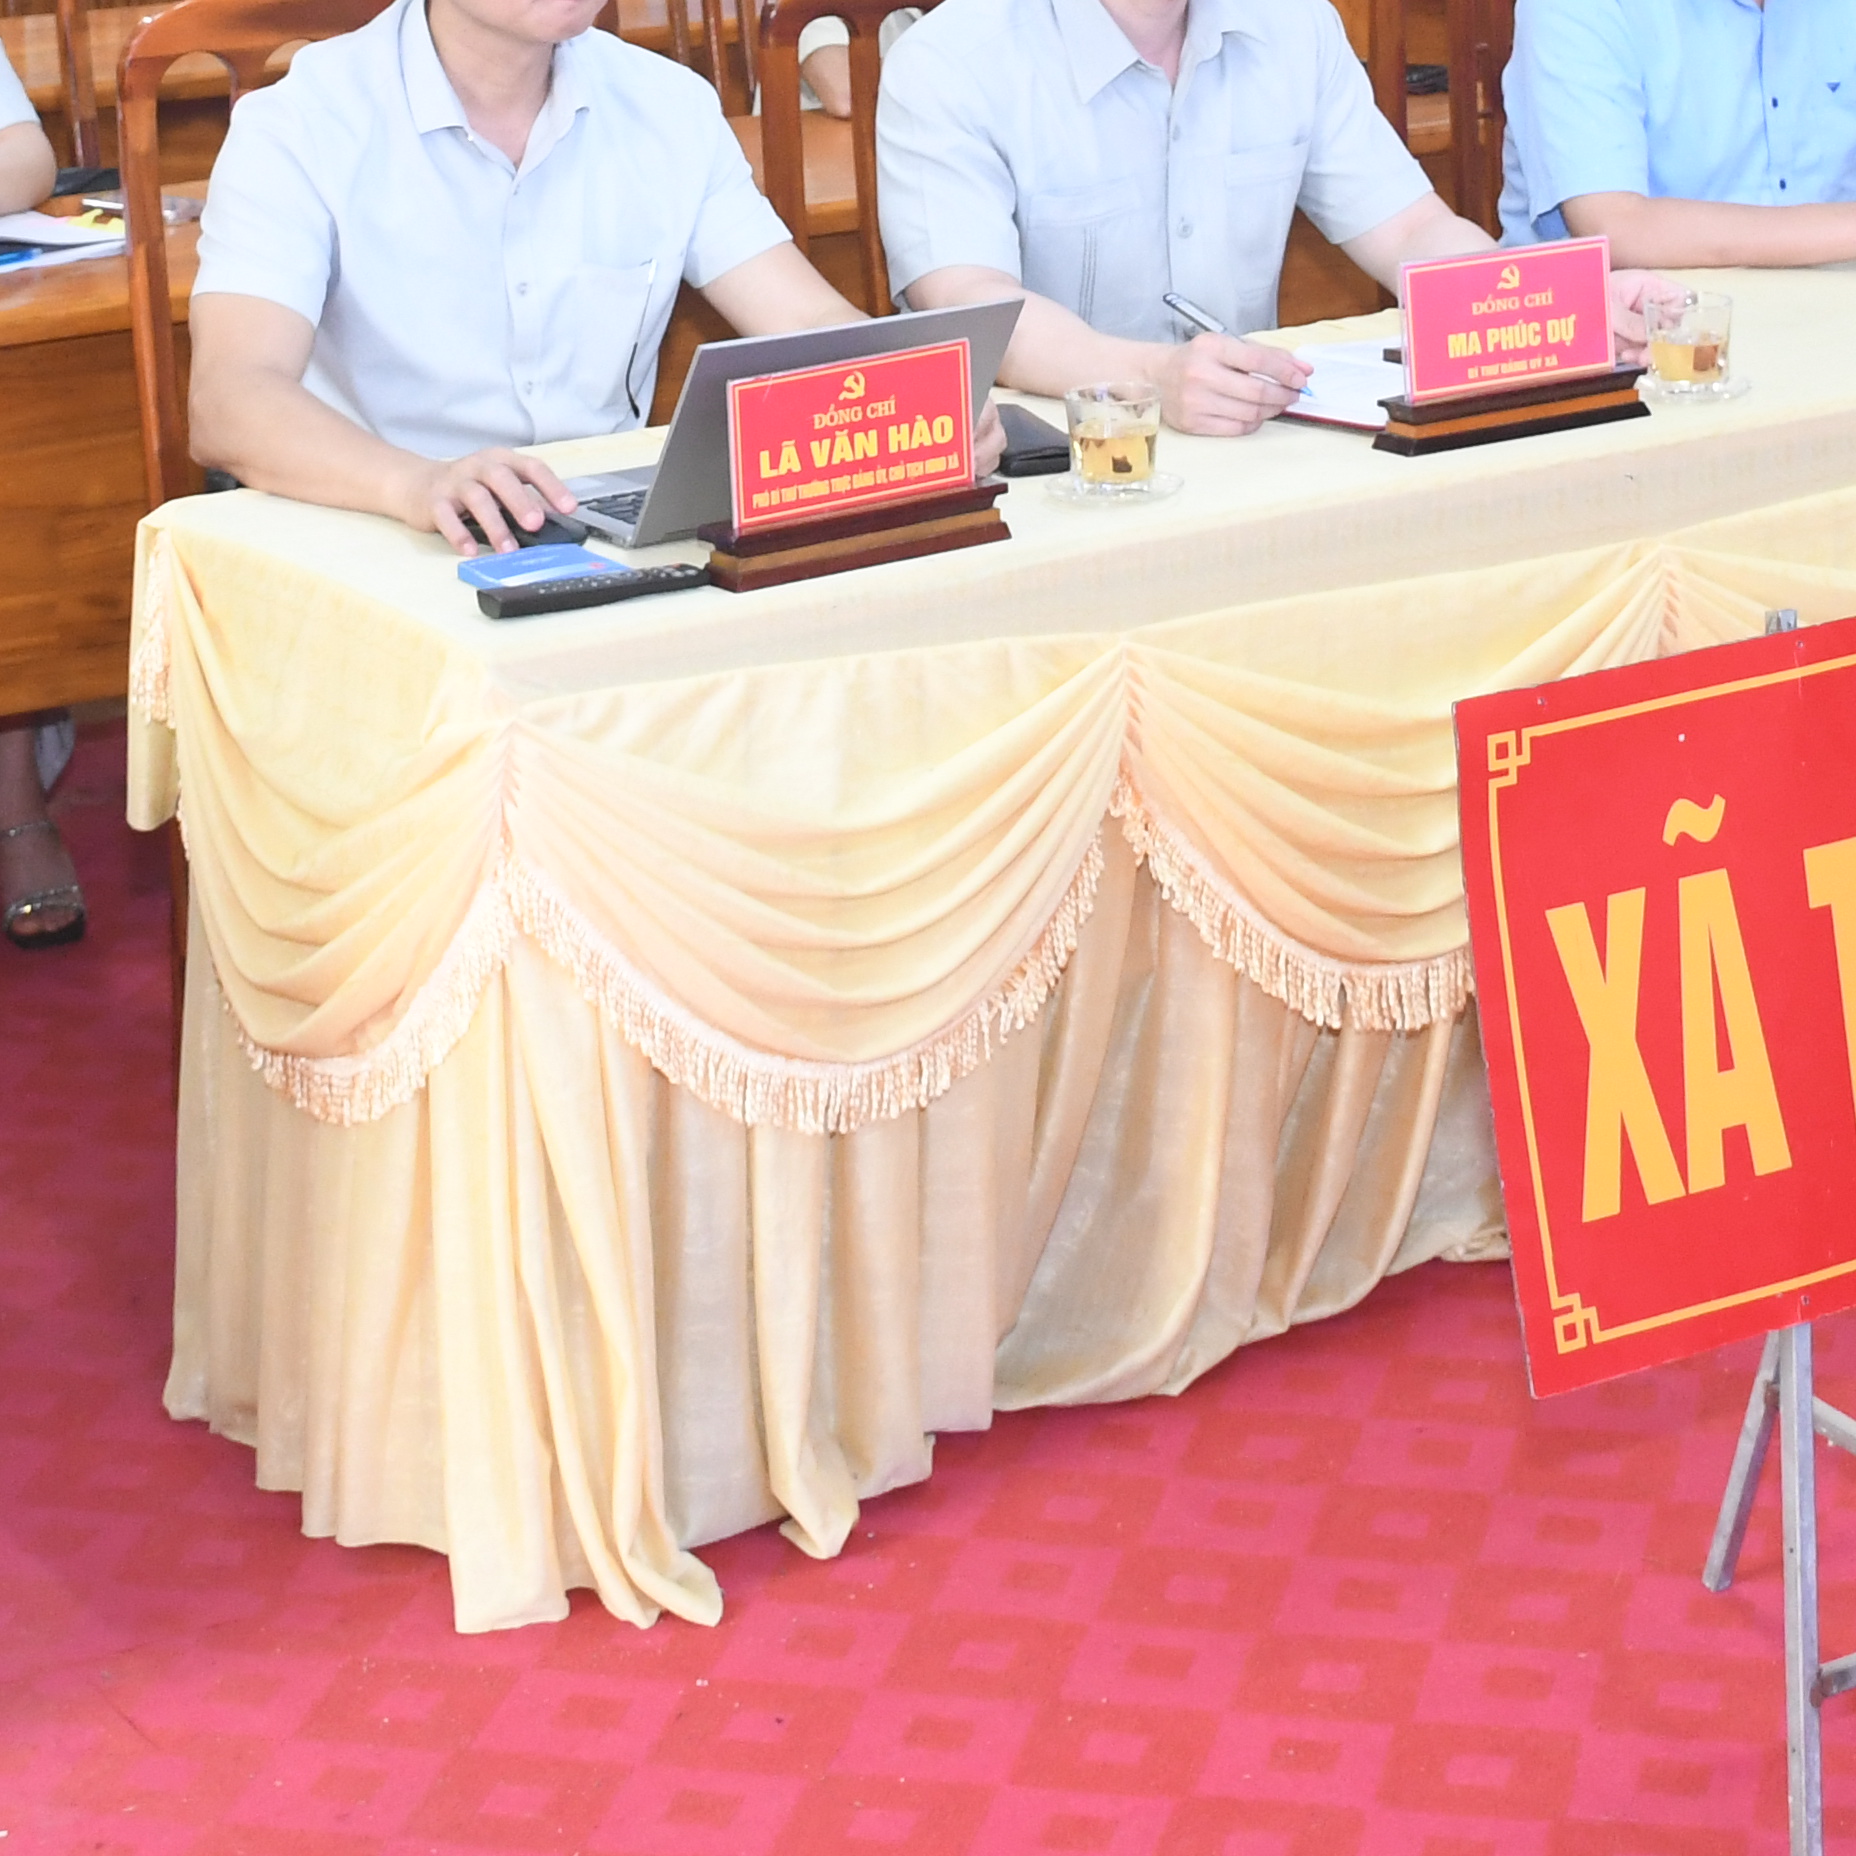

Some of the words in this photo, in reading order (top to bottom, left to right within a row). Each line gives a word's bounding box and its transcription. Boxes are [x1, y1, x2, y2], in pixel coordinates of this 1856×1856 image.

[1524, 287, 1553, 308] CHÍ
[1447, 329, 1482, 359] MA
[1486, 318, 1542, 352] PHÚC
[1546, 313, 1577, 347] DỰ
[813, 403, 863, 430] ĐỒNG
[865, 394, 897, 418] CHÍ
[758, 439, 802, 480] LÃ
[809, 429, 879, 469] VĂN
[887, 414, 955, 454] HÀO
[1545, 792, 1794, 1225] XÃ
